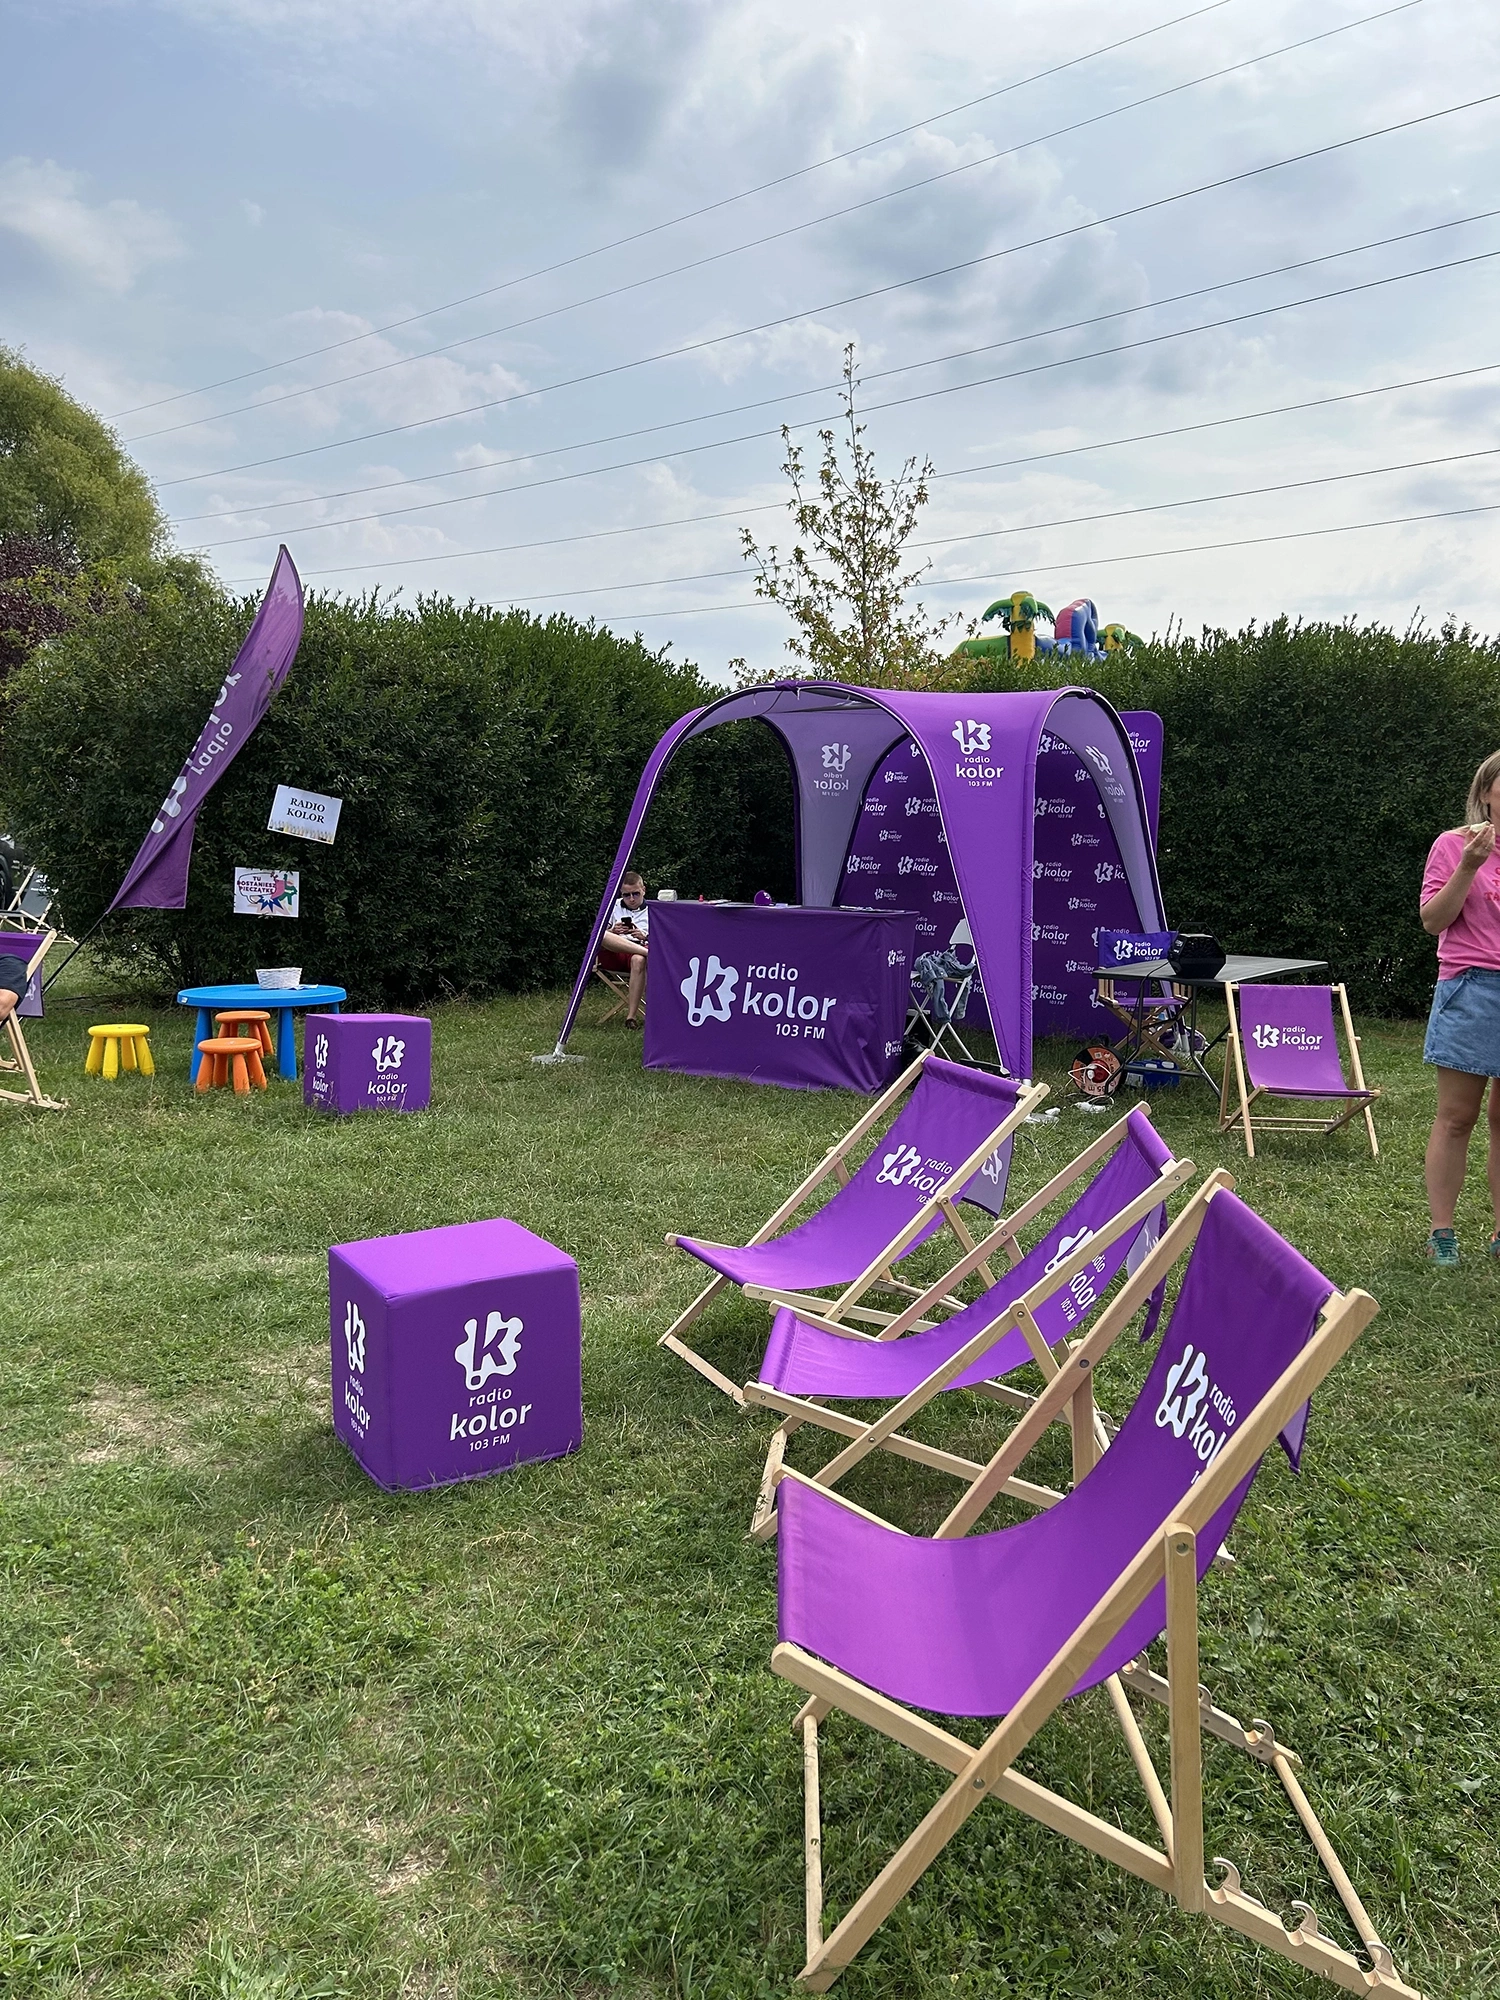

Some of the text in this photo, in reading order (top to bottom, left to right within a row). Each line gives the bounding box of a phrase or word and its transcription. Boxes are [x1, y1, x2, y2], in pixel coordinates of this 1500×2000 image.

[956, 763, 1004, 778] kolor
[290, 798, 326, 812] RADIO
[865, 803, 887, 811] kolor
[1048, 804, 1076, 813] kolor
[286, 808, 325, 823] KOLOR
[860, 861, 881, 870] kolor
[913, 863, 938, 872] kolor
[1044, 867, 1072, 877] kolor
[1041, 930, 1069, 940] kolor
[1134, 947, 1163, 956] kolor
[747, 962, 799, 982] radio
[742, 982, 837, 1021] kolor
[1039, 990, 1067, 1000] kolor
[775, 1024, 826, 1039] 103 FM
[1282, 1033, 1323, 1044] kolor
[312, 1077, 329, 1092] kolor
[367, 1081, 407, 1095] kolor
[924, 1158, 953, 1175] radio
[469, 1387, 512, 1408] radio
[1209, 1383, 1237, 1427] radio
[345, 1381, 370, 1430] kolor
[449, 1403, 532, 1441] kolor
[469, 1433, 511, 1452] 103 FM
